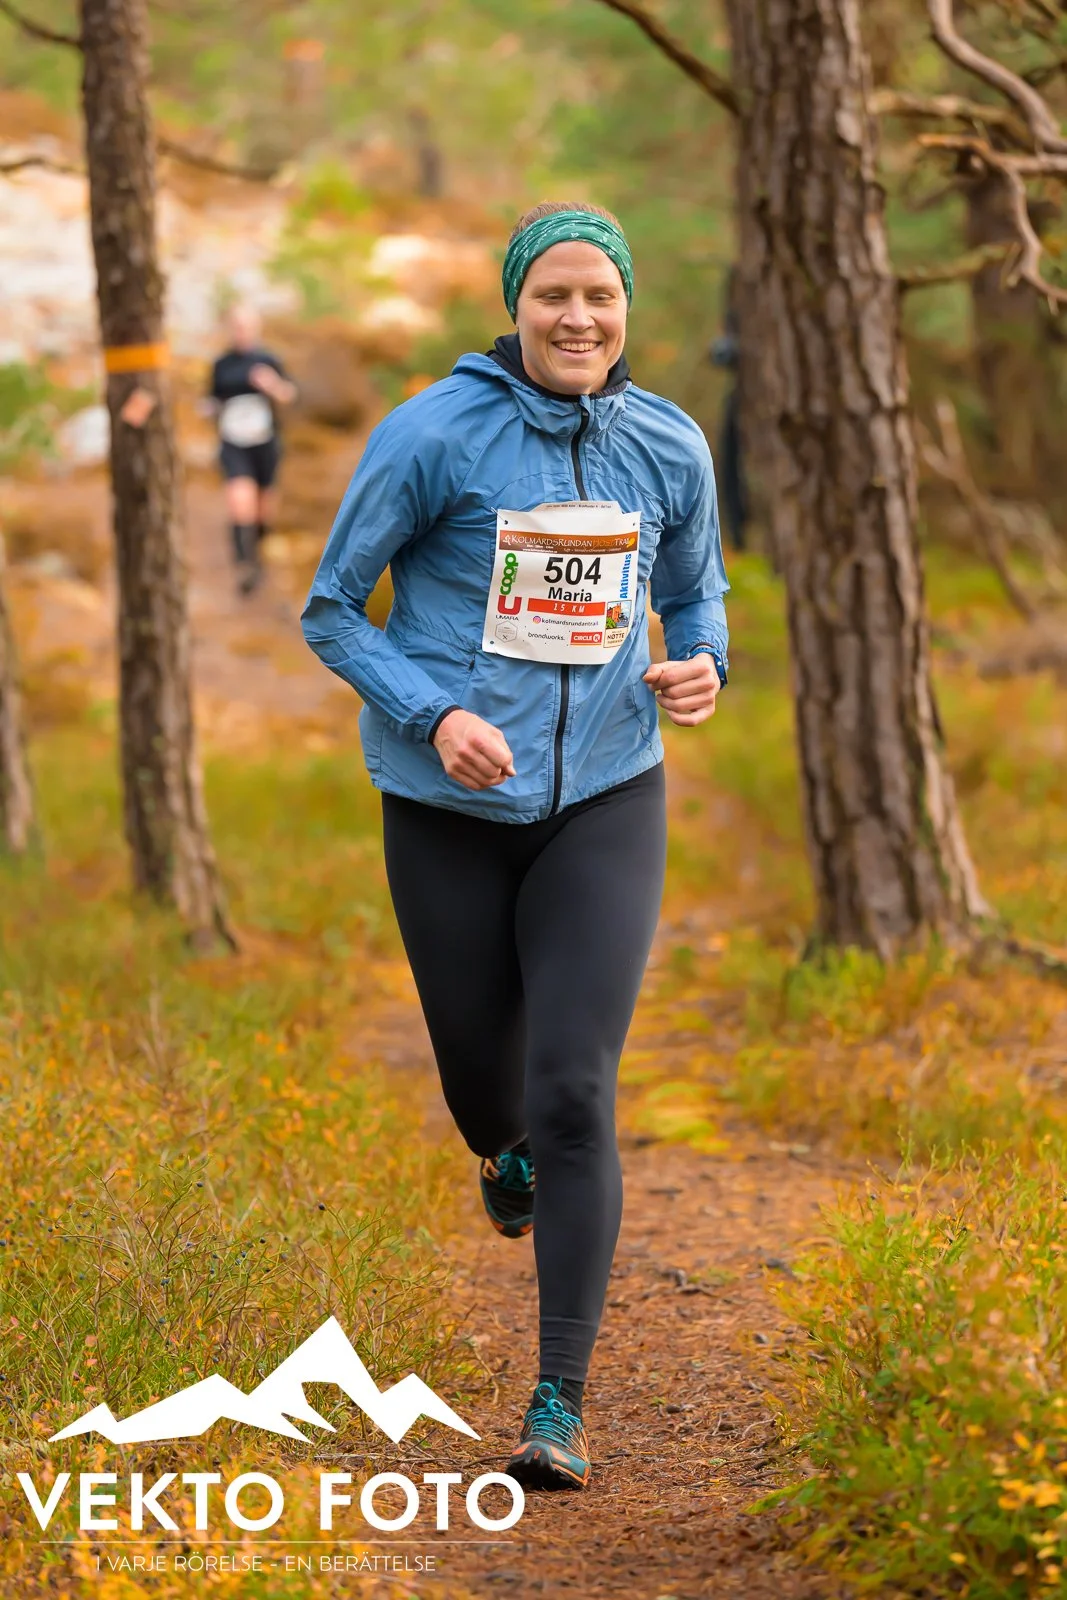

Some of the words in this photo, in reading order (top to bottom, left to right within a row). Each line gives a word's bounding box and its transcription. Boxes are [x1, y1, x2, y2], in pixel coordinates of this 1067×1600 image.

[500, 553, 518, 595] coop
[543, 557, 601, 585] 504
[620, 553, 632, 599] Aktivitus
[548, 587, 592, 602] Maria
